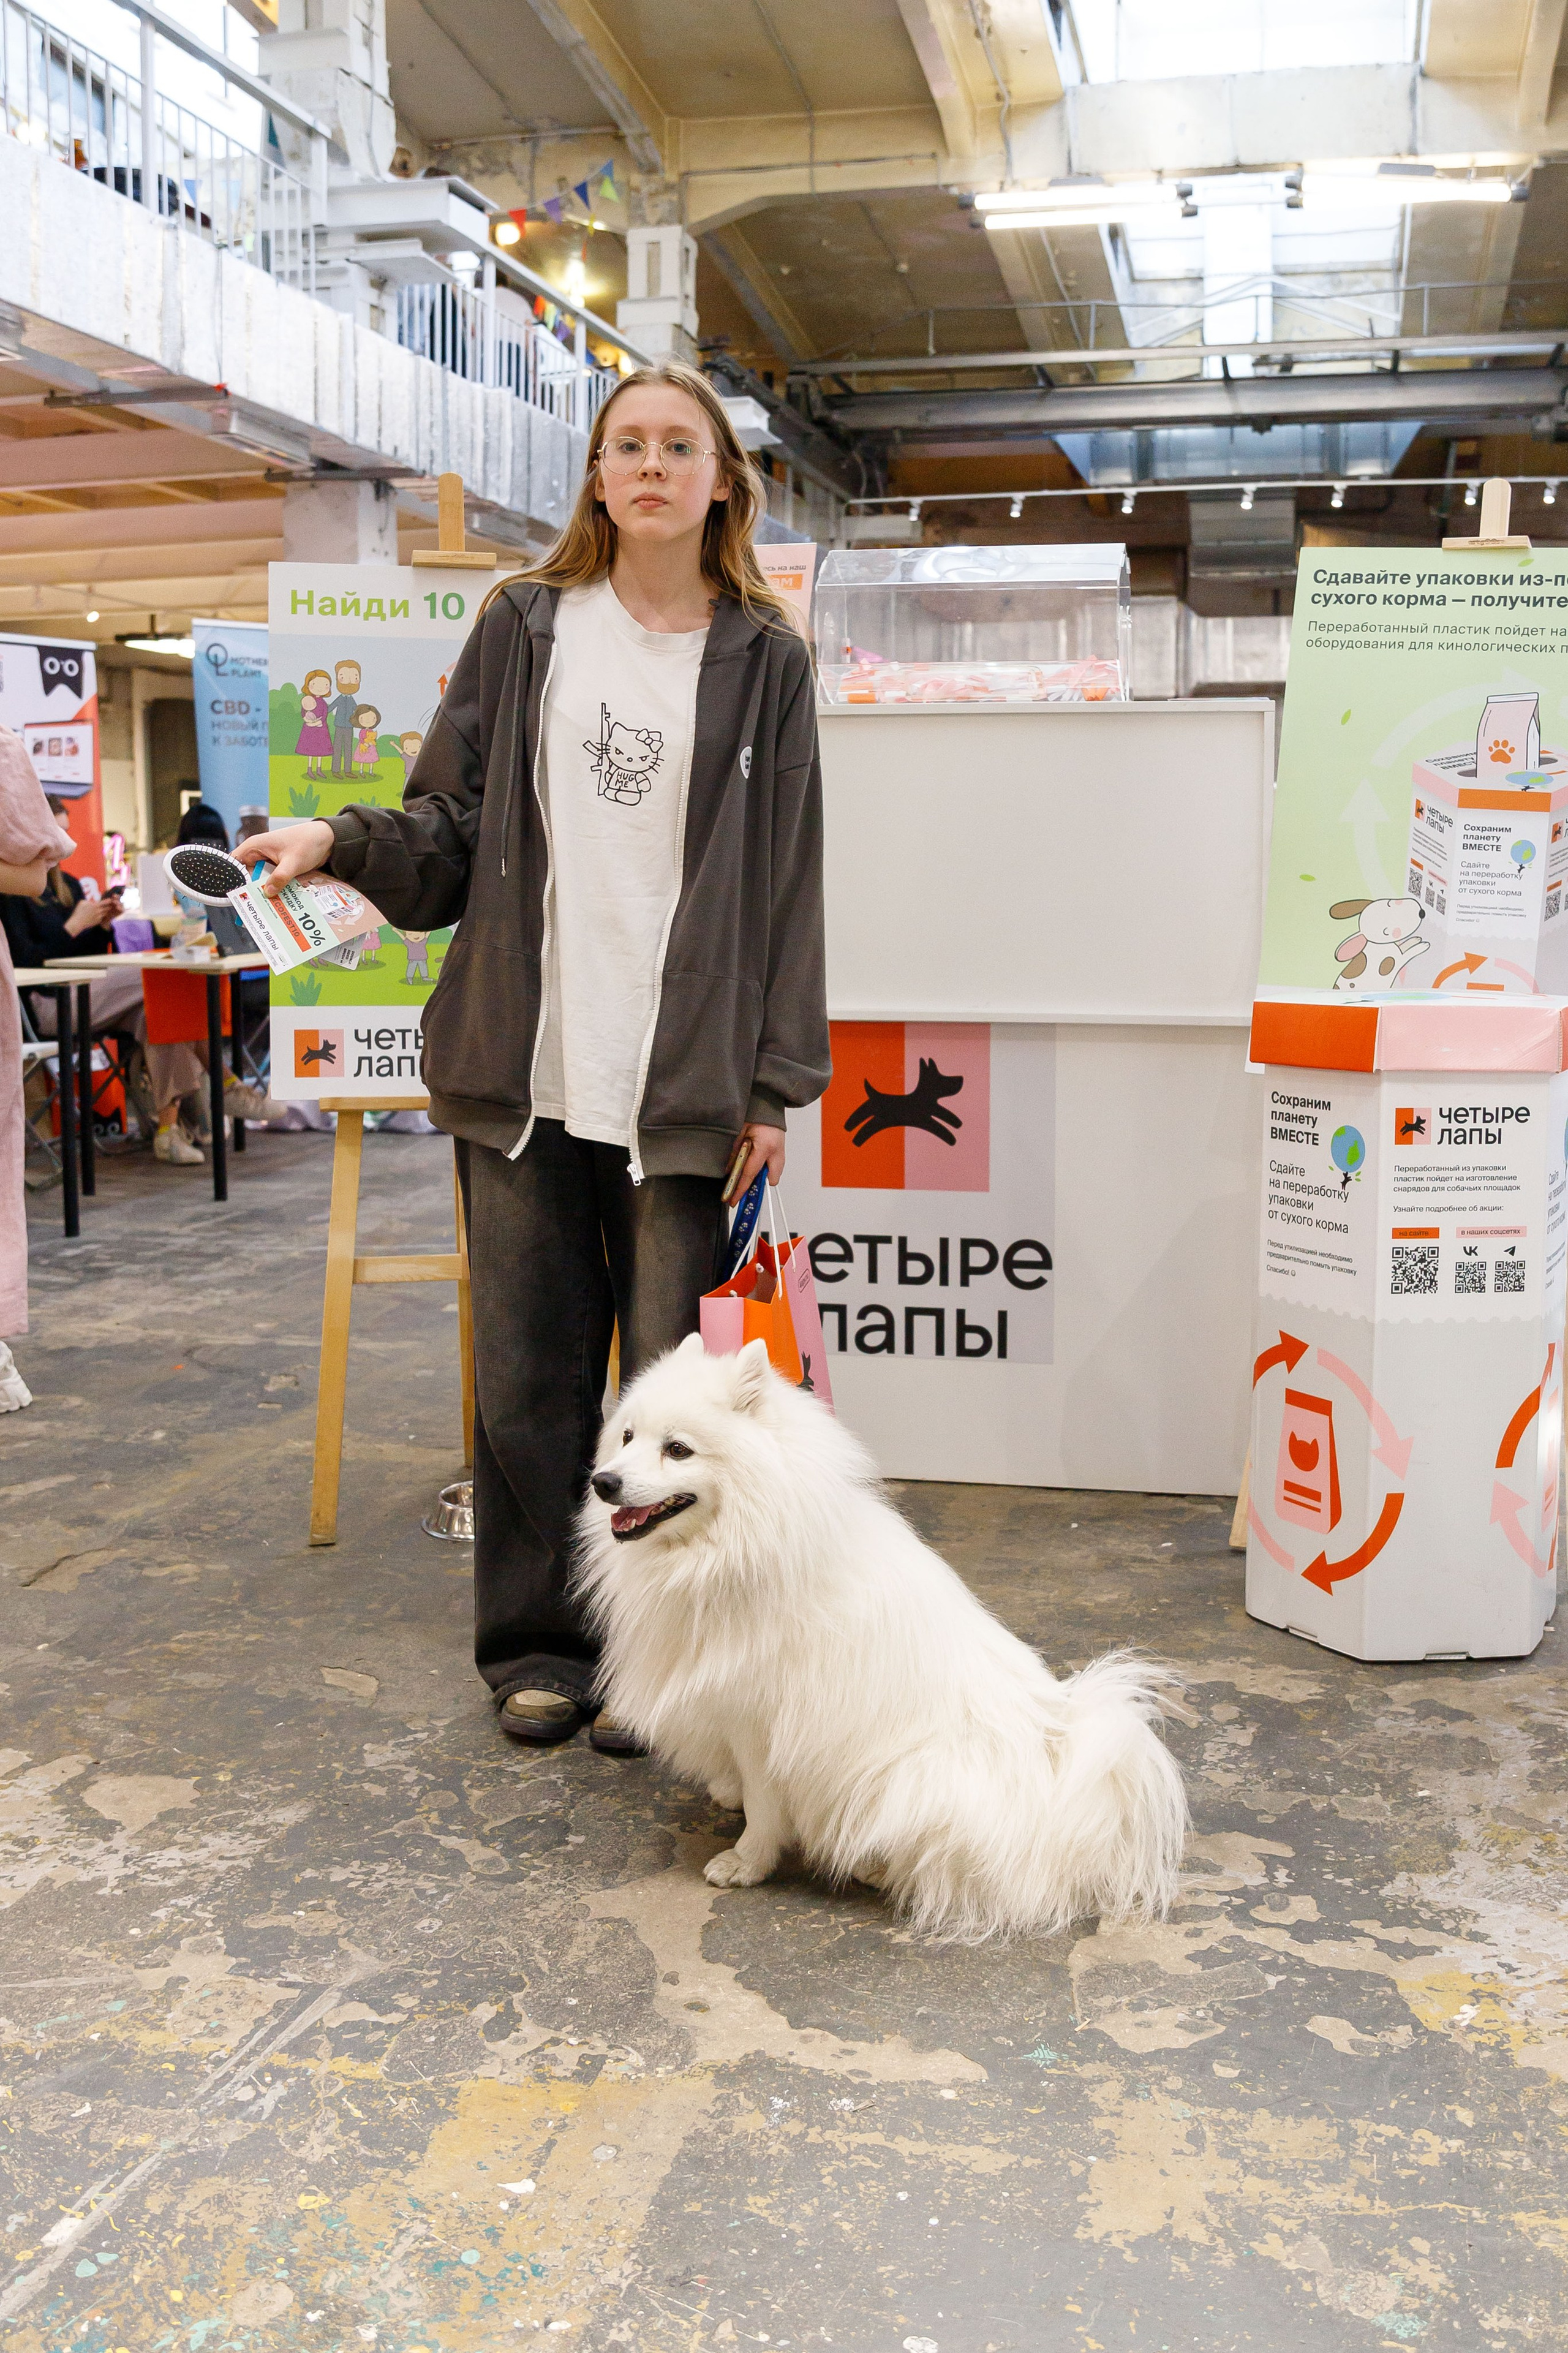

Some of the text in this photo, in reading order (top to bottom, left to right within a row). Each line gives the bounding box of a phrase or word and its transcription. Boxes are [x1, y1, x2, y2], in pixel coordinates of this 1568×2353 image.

[1313, 568, 1568, 588] Сдавайте упаковки из-п
[291, 589, 465, 621] Найди 10
[1311, 592, 1377, 607] сухого
[1382, 592, 1447, 609] корма
[1471, 595, 1568, 611] получите
[1308, 621, 1567, 637] Переработанный пластик пойдет на
[1306, 637, 1404, 651] оборудования
[1408, 639, 1433, 651] для
[1438, 641, 1556, 654] кинологических
[211, 700, 251, 714] CBD
[615, 780, 629, 788] ME
[616, 771, 635, 782] HUG
[1464, 824, 1512, 833] Сохраним
[1462, 843, 1502, 852] ВМЕСТЕ
[1471, 872, 1523, 880] переработку
[285, 885, 304, 910] ОМОКОД
[246, 901, 266, 931] четыре
[263, 929, 279, 951] лапы
[298, 912, 326, 946] 10%
[354, 1029, 424, 1050] чет
[353, 1056, 421, 1077] лап
[1271, 1091, 1331, 1111] Сохраним
[1271, 1111, 1318, 1128] планету
[1438, 1106, 1531, 1124] четыре
[1270, 1127, 1319, 1146] ВМЕСТЕ
[1438, 1127, 1502, 1146] лапы
[1269, 1160, 1305, 1177] Сдайте
[1394, 1165, 1460, 1173] Переработанный
[1269, 1178, 1349, 1203] на переработку
[1268, 1193, 1314, 1210] упаковки
[1268, 1209, 1349, 1233] от сухого корма
[1267, 1239, 1353, 1263] Перед утилизацией необходимо
[761, 1232, 1053, 1290] етыре
[1310, 1260, 1330, 1270] помыть
[1332, 1265, 1357, 1276] упаковку
